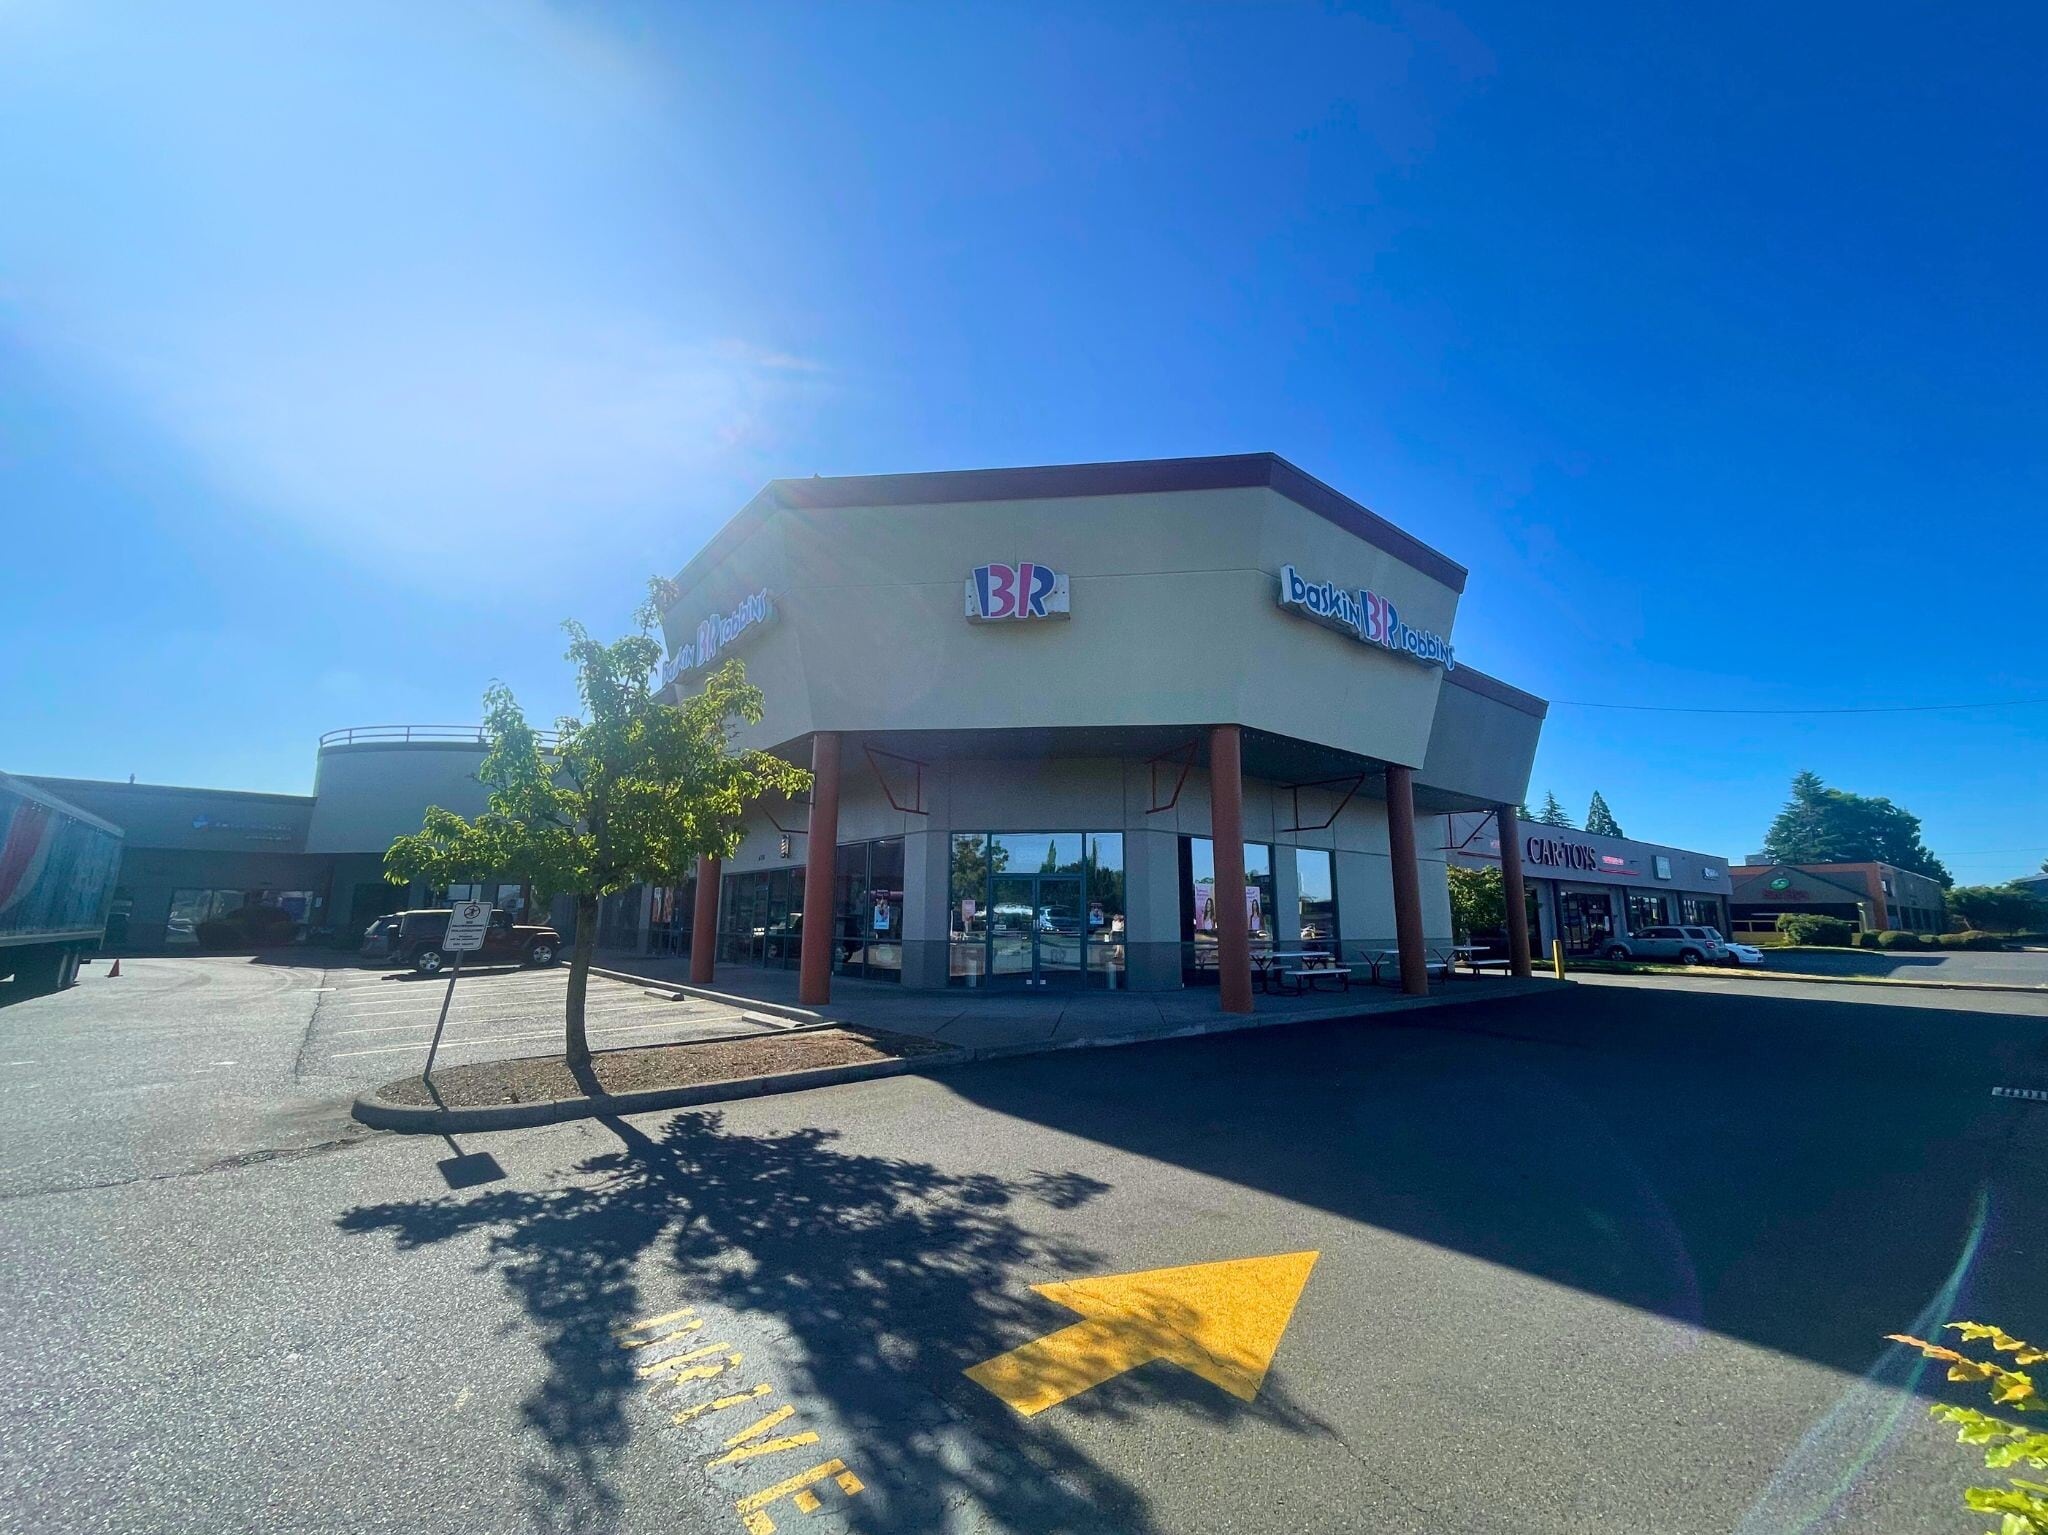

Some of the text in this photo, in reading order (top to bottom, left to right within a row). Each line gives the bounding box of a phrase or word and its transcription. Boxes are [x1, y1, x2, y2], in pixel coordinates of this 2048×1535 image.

[973, 562, 1056, 618] BR
[696, 614, 720, 667] BR
[1359, 590, 1399, 649] BR
[1401, 622, 1455, 671] robbins
